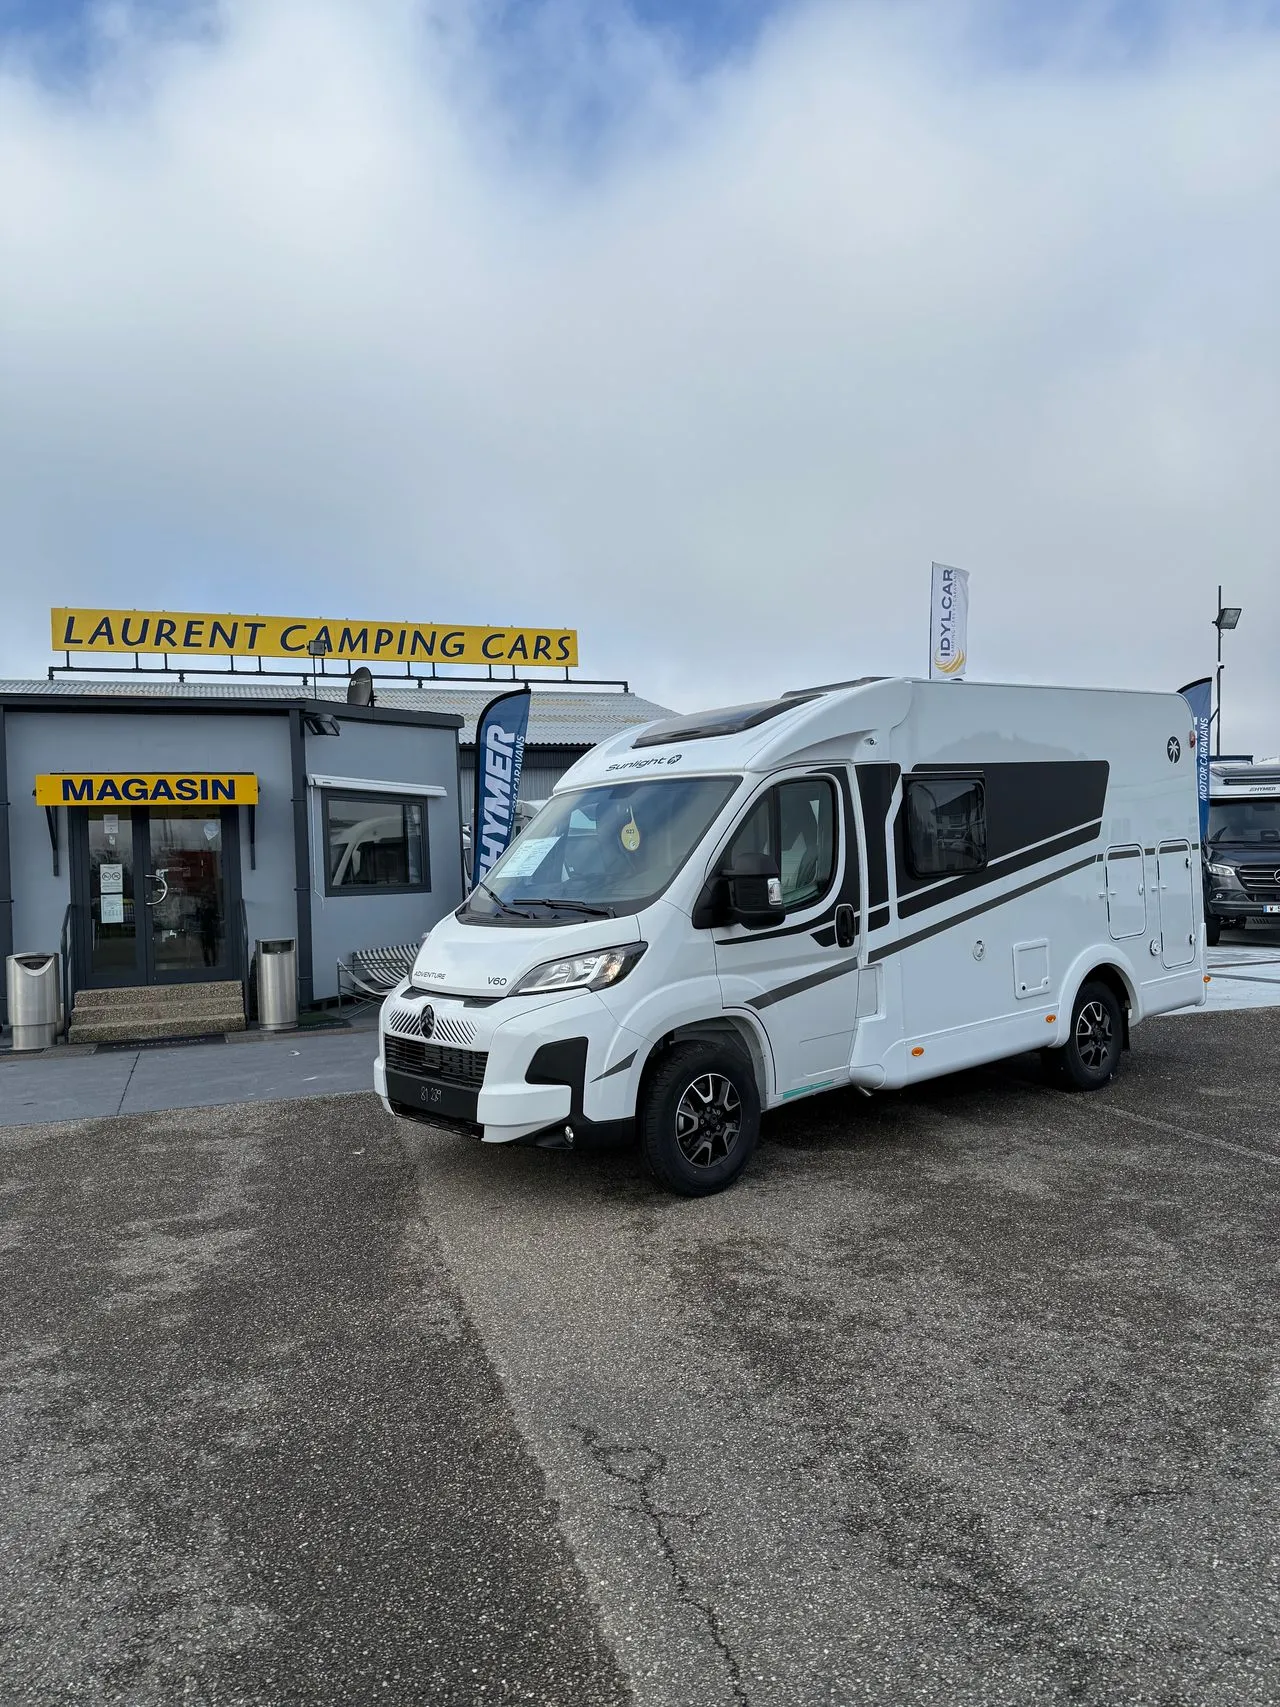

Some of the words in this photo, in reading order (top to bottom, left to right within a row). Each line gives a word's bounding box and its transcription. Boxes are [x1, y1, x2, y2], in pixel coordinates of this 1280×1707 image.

[940, 569, 954, 657] IDYLCAR
[63, 616, 267, 650] LAURENT
[280, 624, 465, 657] CAMPING
[482, 633, 571, 661] CARS
[1199, 717, 1209, 765] CARAVANS
[62, 778, 236, 801] MAGASIN
[480, 724, 516, 868] HYMER
[1199, 766, 1208, 801] MOTOR
[414, 970, 447, 980] ADVENTURE
[487, 976, 508, 986] V60
